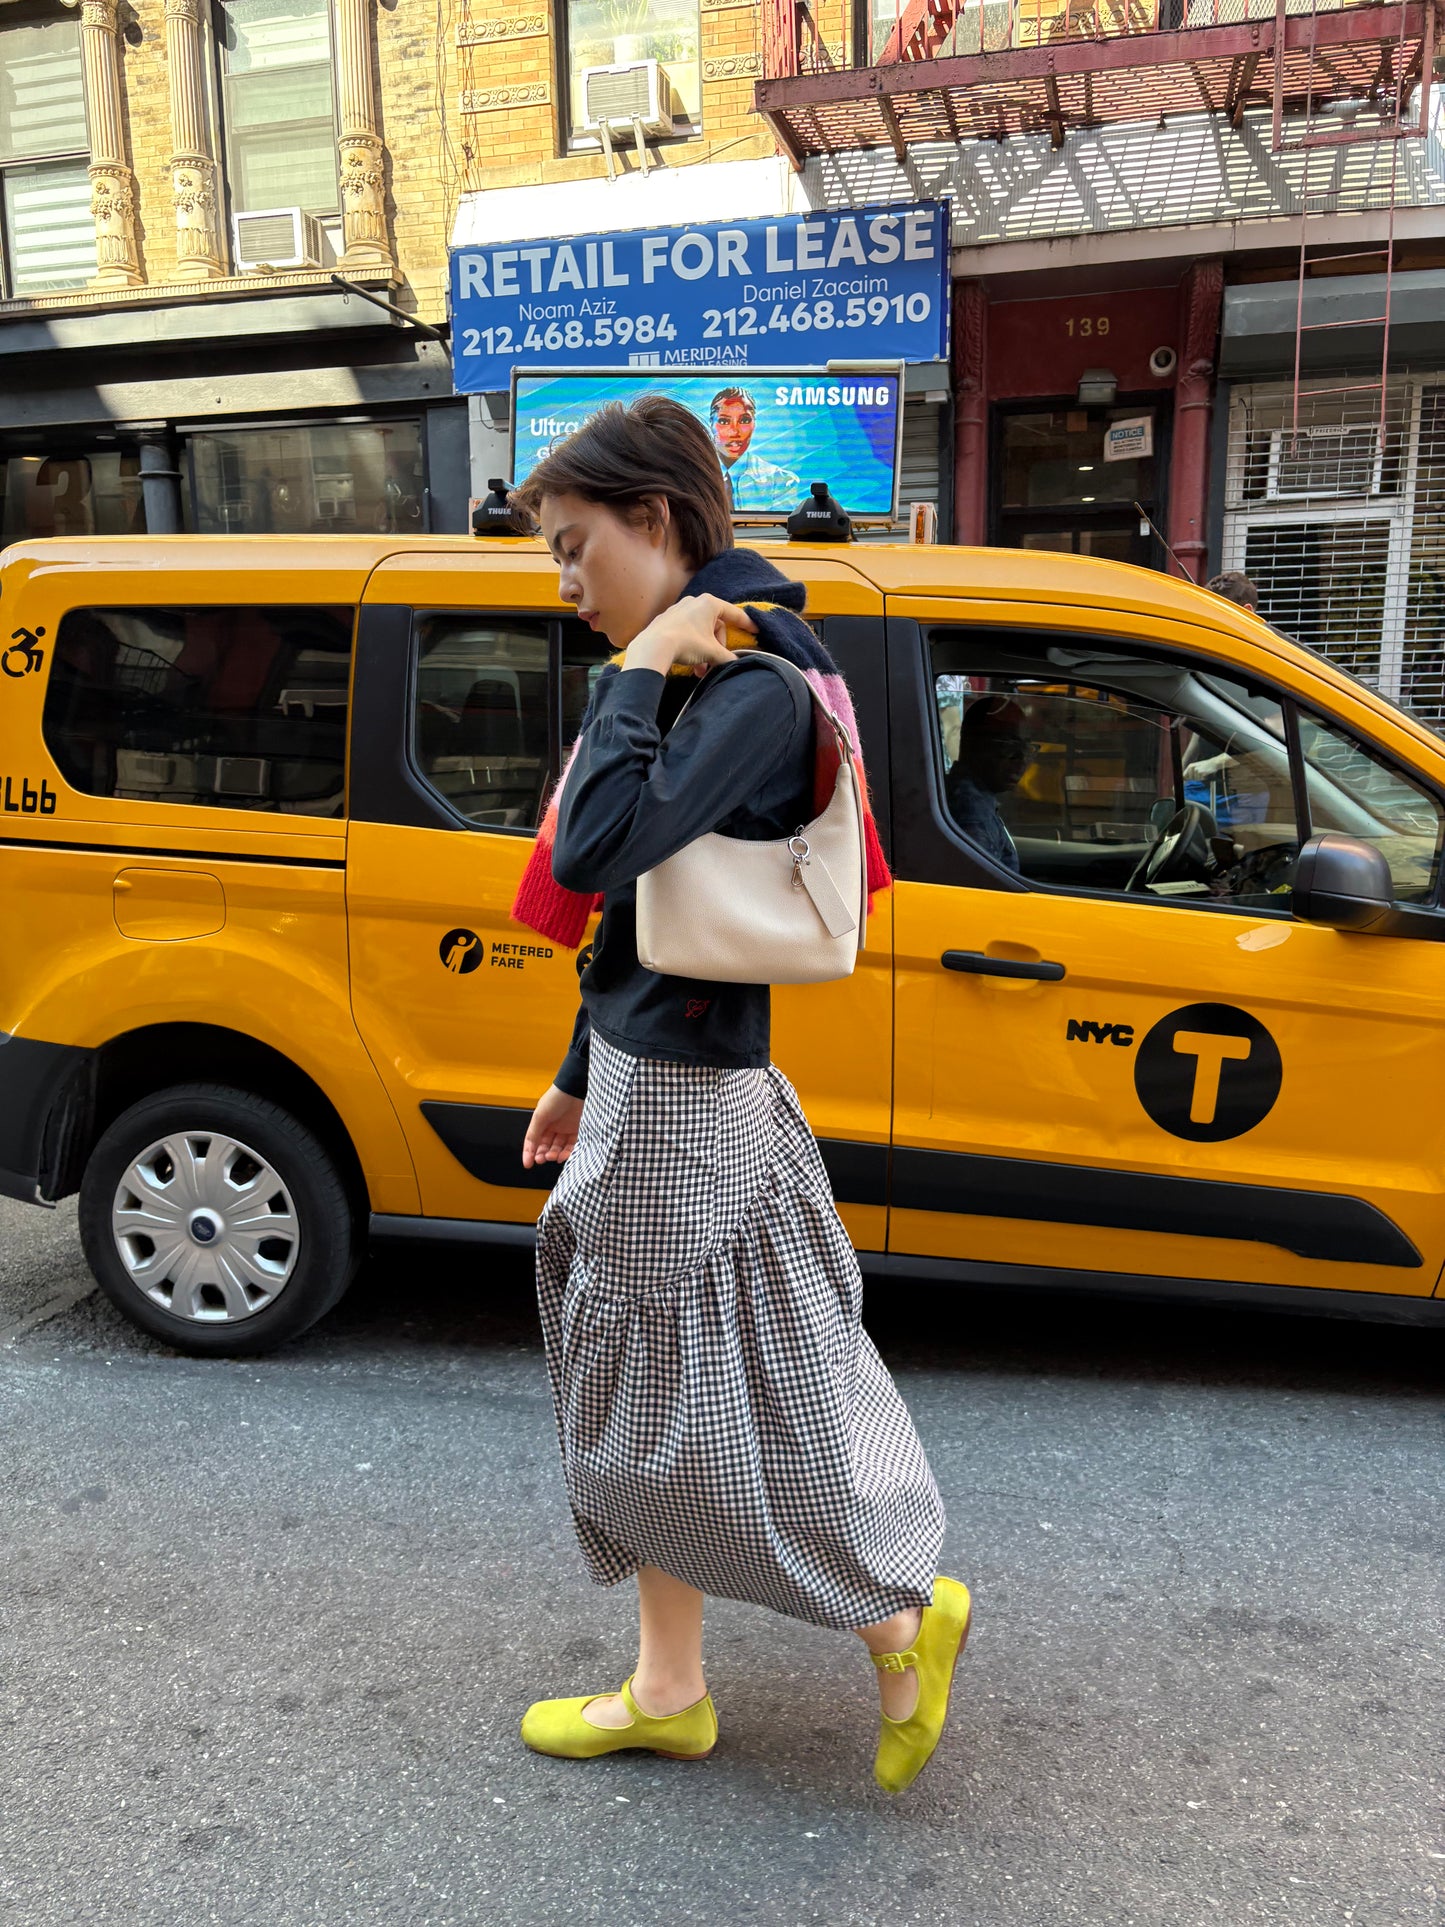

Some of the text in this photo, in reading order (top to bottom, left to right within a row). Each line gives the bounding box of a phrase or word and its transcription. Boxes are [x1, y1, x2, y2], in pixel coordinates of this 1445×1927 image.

[459, 210, 935, 300] RETAIL FOR LEASE
[743, 275, 888, 304] Daniel Zacaim
[519, 297, 617, 322] Noam Aziz
[702, 292, 931, 338] 212.468.5910
[462, 313, 677, 356] 212.468.5984
[1065, 317, 1110, 337] 139
[663, 344, 748, 363] MERIDIAN
[775, 386, 890, 406] SAMSUNG
[530, 418, 579, 437] Ultra
[1112, 427, 1143, 440] NOTICE
[487, 507, 512, 515] THULE
[806, 511, 832, 519] THULE
[491, 942, 554, 959] METERED
[490, 956, 525, 970] FARE
[1066, 1019, 1134, 1047] NYC
